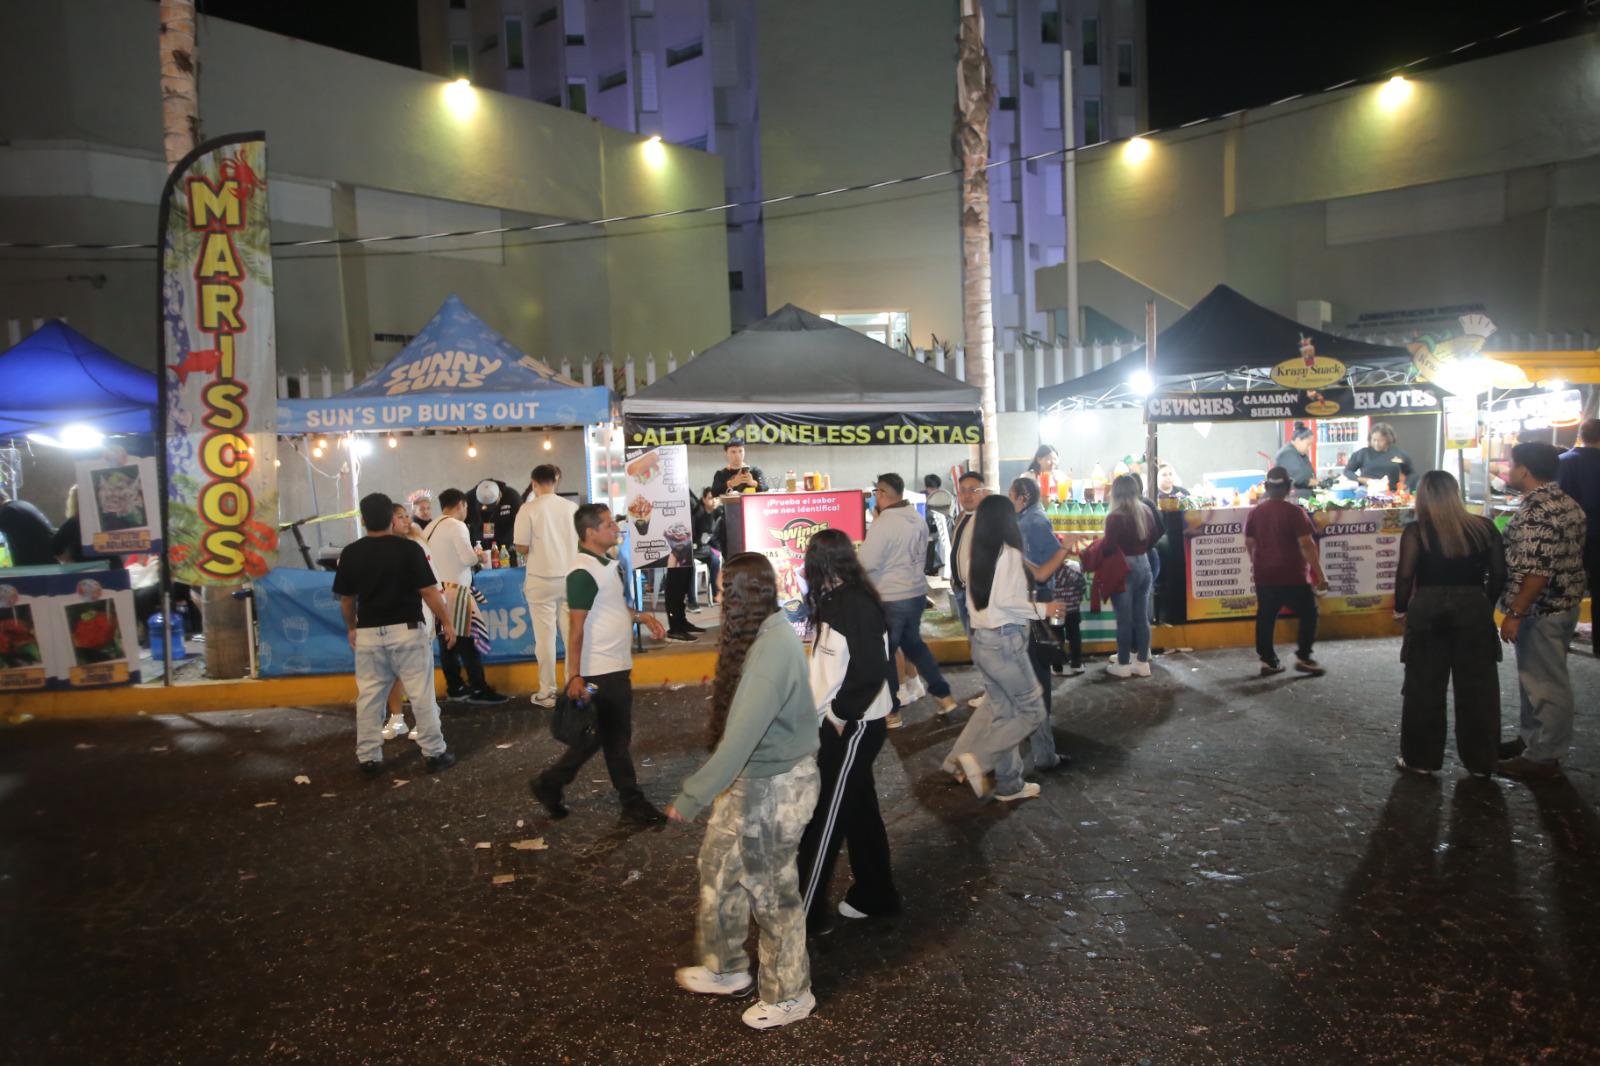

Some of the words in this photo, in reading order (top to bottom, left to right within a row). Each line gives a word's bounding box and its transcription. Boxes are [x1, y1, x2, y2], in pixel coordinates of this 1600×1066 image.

[188, 178, 251, 577] MARISCOS
[1277, 367, 1308, 378] Krazy
[1310, 364, 1341, 374] Snack
[1243, 392, 1298, 405] CAMARÓN
[1353, 389, 1437, 410] ELOTES
[382, 405, 412, 424] UP
[492, 402, 539, 420] OUT
[1149, 397, 1235, 416] CEVICHES
[1250, 406, 1292, 417] SIERRA
[642, 425, 732, 446] ALITAS
[745, 424, 871, 444] BONELESS
[884, 425, 980, 444] TORTAS
[767, 498, 800, 508] ¡Prueba
[812, 496, 837, 504] sabor
[797, 504, 840, 514] identifica!
[1203, 523, 1241, 535] ELOTES
[1325, 523, 1375, 535] CEVICHES
